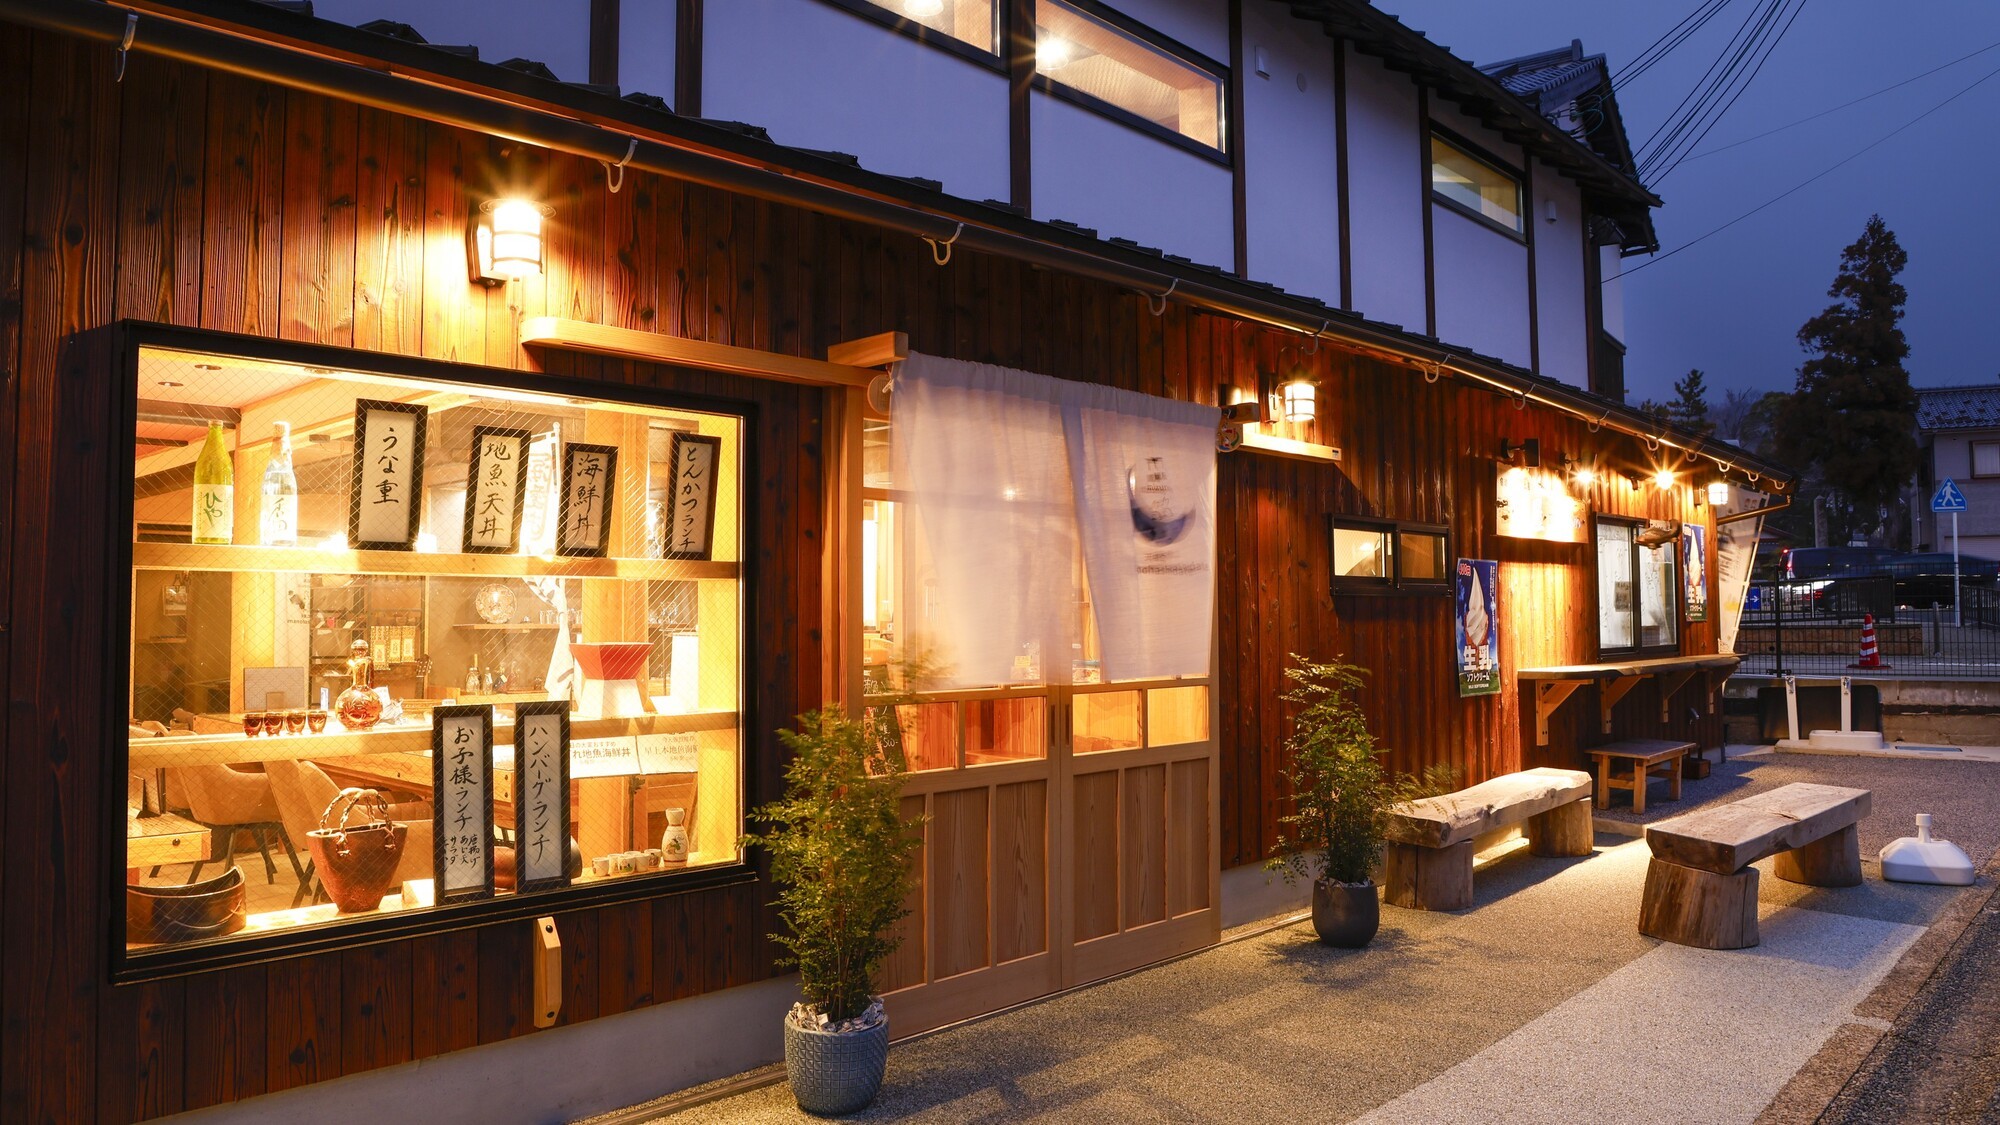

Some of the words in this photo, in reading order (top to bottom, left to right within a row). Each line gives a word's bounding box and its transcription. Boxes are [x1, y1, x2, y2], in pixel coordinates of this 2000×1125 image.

[373, 427, 399, 505] うな重
[477, 441, 511, 542] 地魚天丼
[571, 453, 603, 543] 海鮮丼
[678, 446, 704, 552] とんかつランチ
[1463, 644, 1492, 672] 生乳
[448, 725, 479, 833] お子様ランチ
[529, 726, 552, 866] ハンバーグランチ
[450, 835, 458, 866] サラダ
